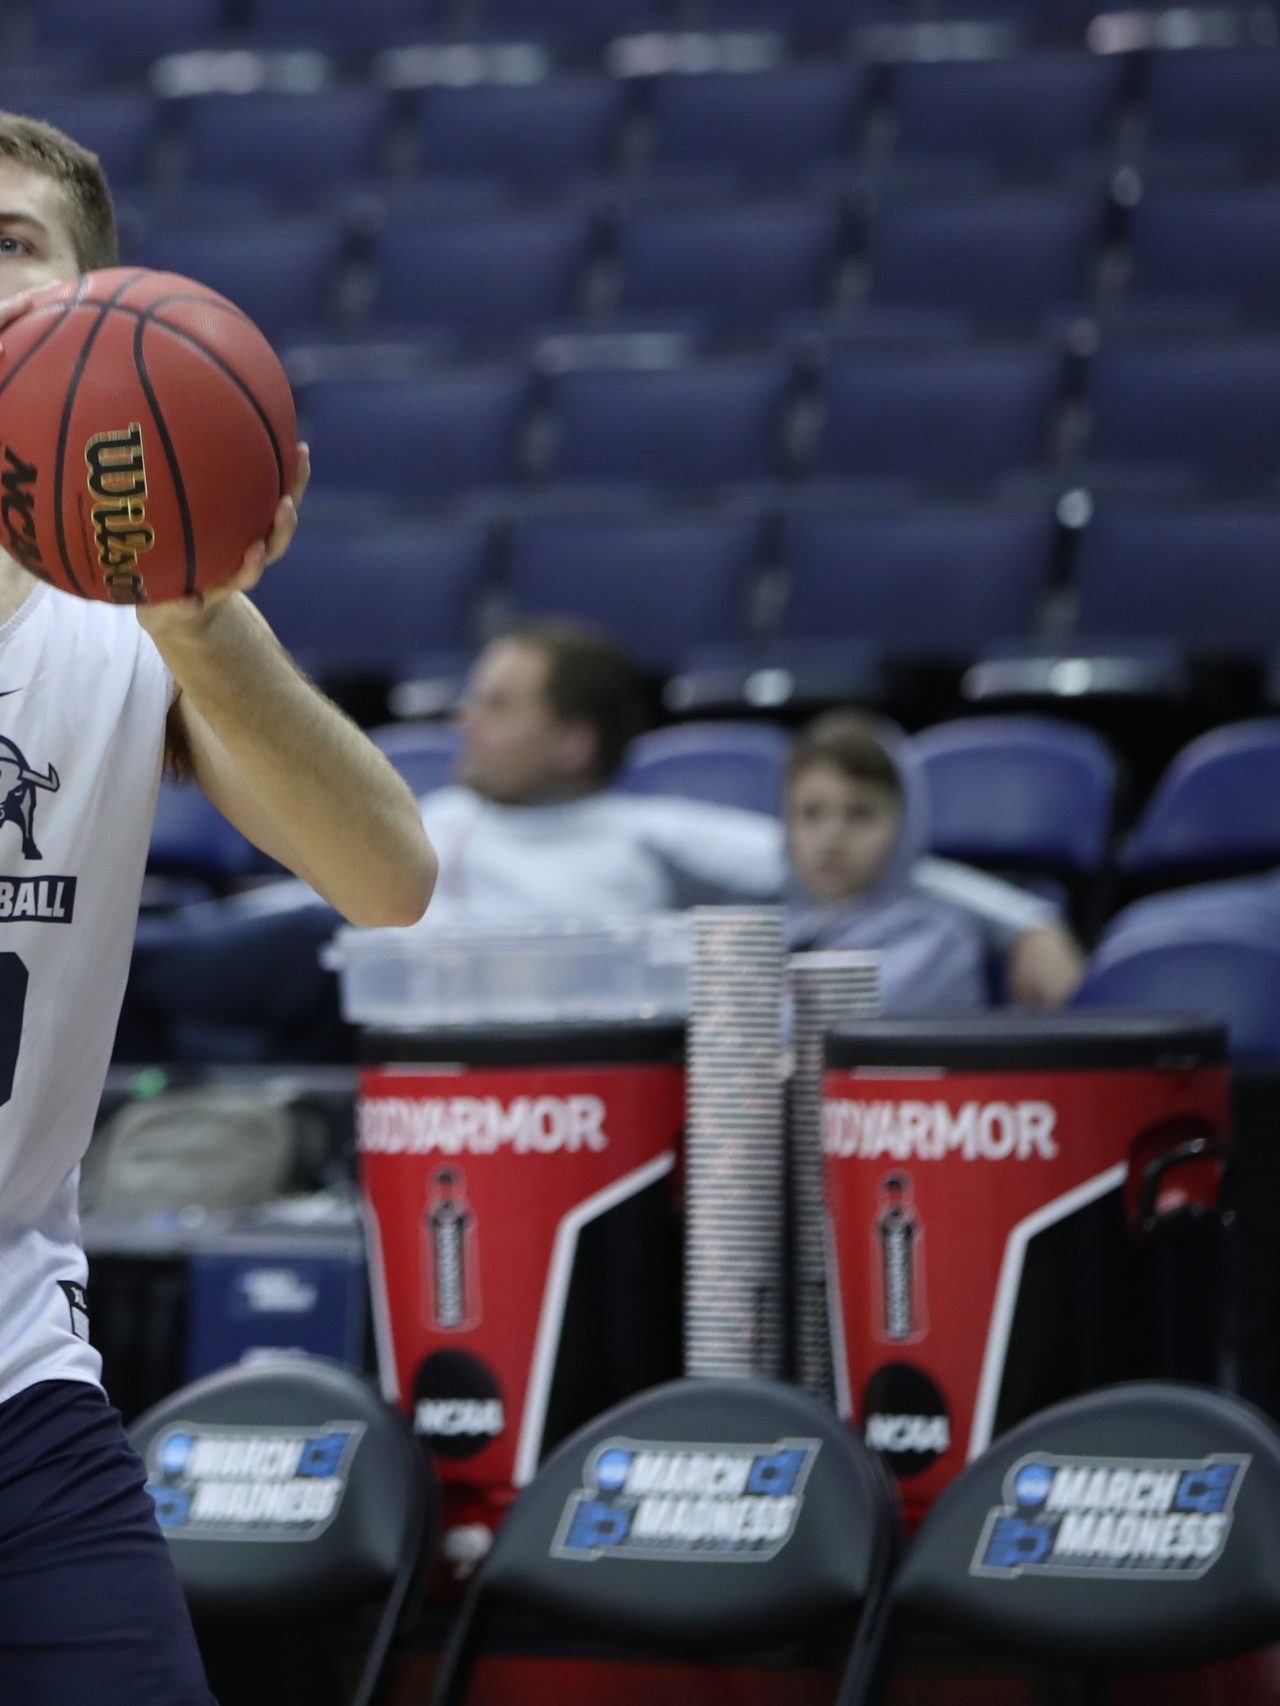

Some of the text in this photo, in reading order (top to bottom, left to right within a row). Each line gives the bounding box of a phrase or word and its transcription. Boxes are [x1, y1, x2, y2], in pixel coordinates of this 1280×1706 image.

[1, 446, 56, 583] NCA
[84, 422, 154, 603] Wilso
[623, 1451, 754, 1496] MARCH
[1045, 1465, 1181, 1513] MARCH
[630, 1496, 798, 1542] MADNESS
[1053, 1512, 1228, 1559] MADNESS
